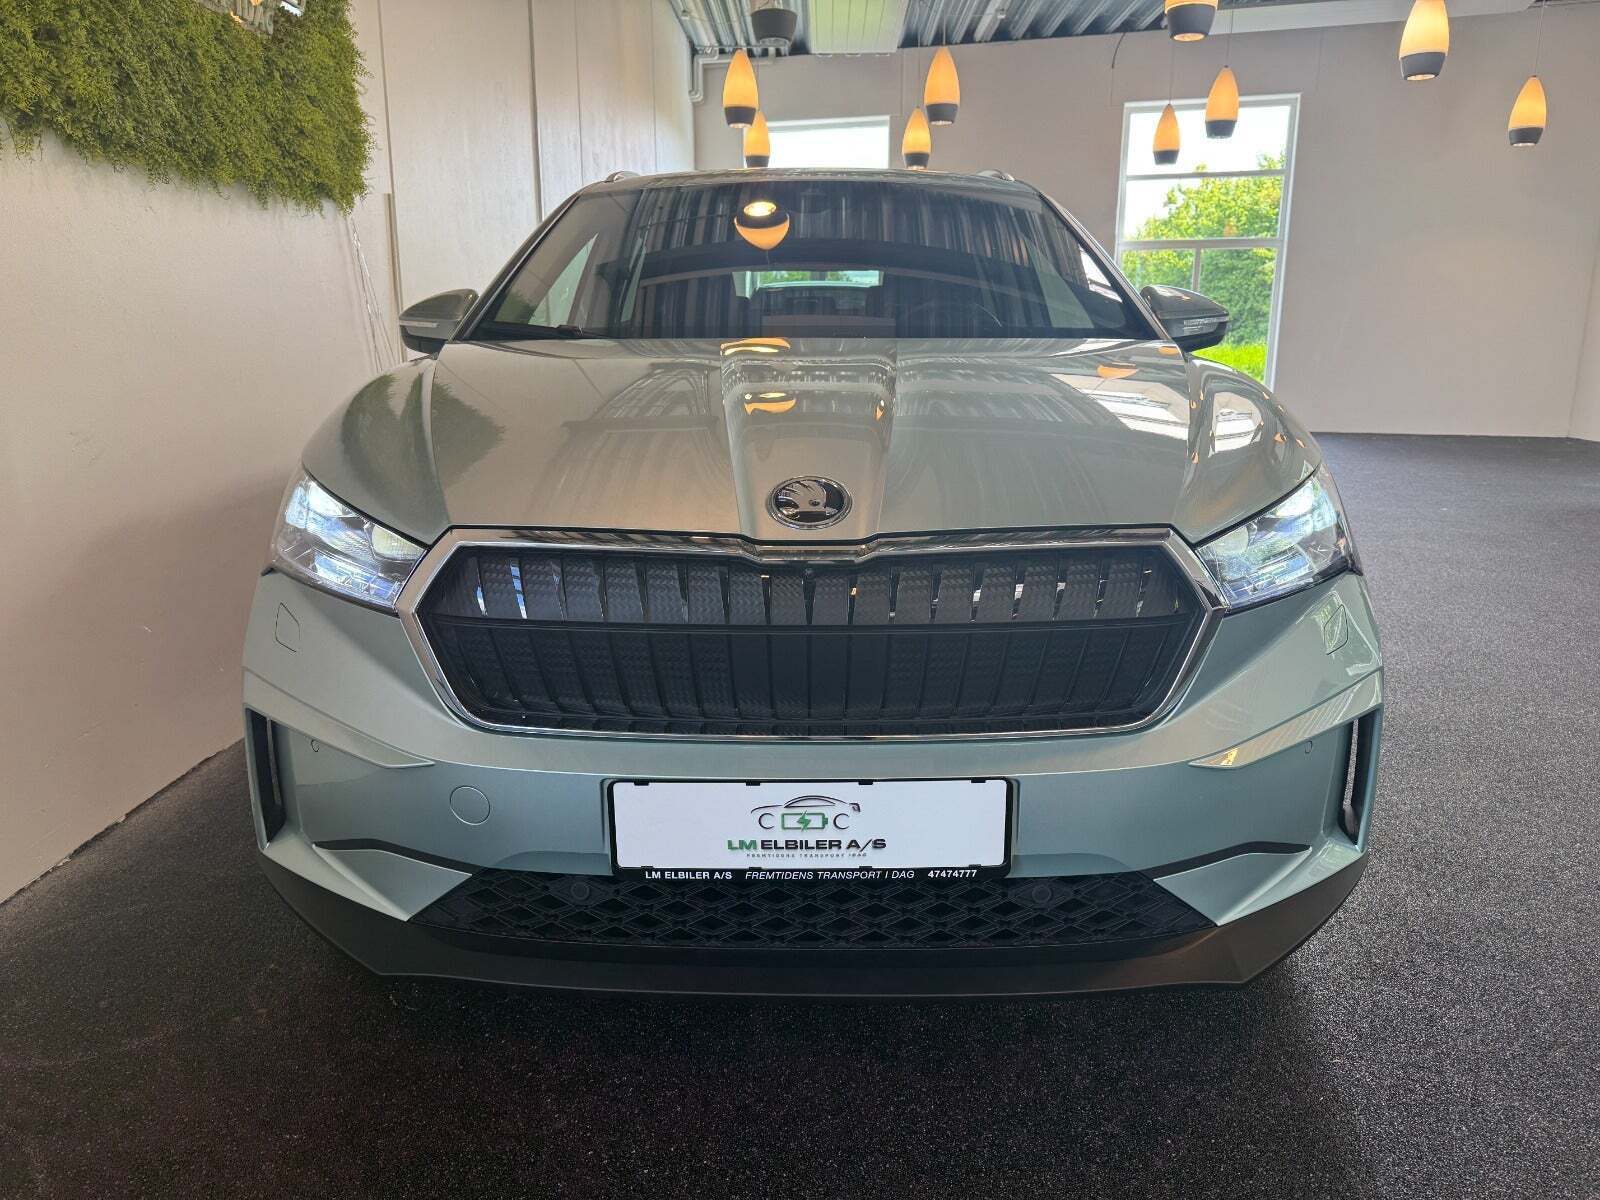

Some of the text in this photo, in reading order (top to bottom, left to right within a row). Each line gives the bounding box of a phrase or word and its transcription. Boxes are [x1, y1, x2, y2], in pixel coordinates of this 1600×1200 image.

[727, 838, 887, 852] LM ELBILER A/S
[645, 869, 977, 880] LM ELBILER A/S FREMTIDENS TRANSPORT I DAG 47474777
